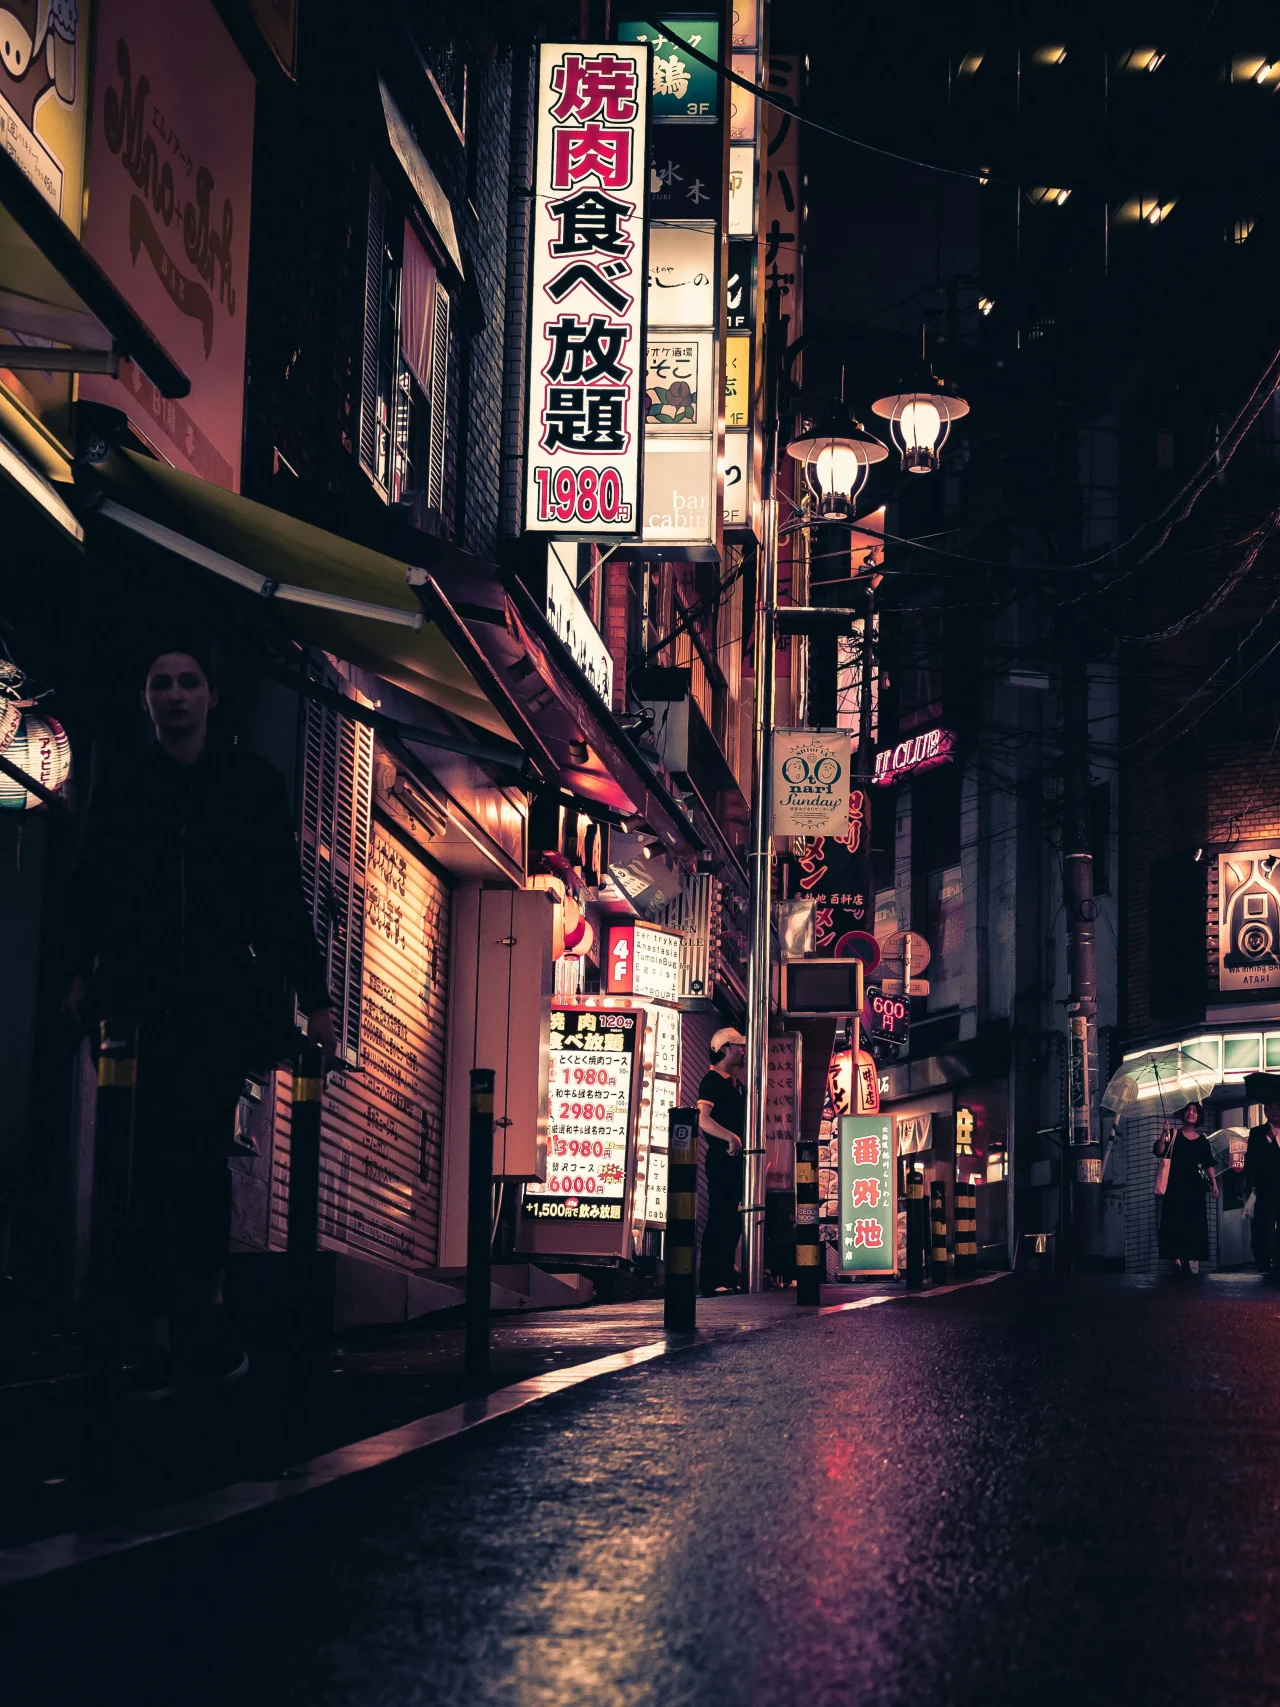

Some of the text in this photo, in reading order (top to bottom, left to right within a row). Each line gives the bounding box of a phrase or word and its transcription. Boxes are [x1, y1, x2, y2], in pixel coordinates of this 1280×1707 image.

[687, 103, 709, 115] 3F
[543, 54, 638, 458] 焼肉食べ放題
[647, 359, 693, 379] そこ
[534, 466, 633, 522] 1,980円
[673, 490, 708, 510] bar
[648, 509, 709, 528] cabin
[893, 730, 940, 769] CLUB
[788, 785, 833, 795] nari
[780, 793, 842, 812] Sunday
[1243, 974, 1270, 984] ATARI
[873, 997, 905, 1018] 600
[599, 1015, 634, 1029] 120分
[883, 1014, 894, 1032] 円
[559, 1055, 628, 1065] とくとく焼肉コース
[562, 1068, 616, 1086] 1980円
[829, 1063, 849, 1114] ラーメン
[560, 1103, 614, 1120] 2980円
[557, 1140, 612, 1158] 3980円
[549, 1176, 604, 1193] 6000円
[852, 1135, 883, 1248] 番外地
